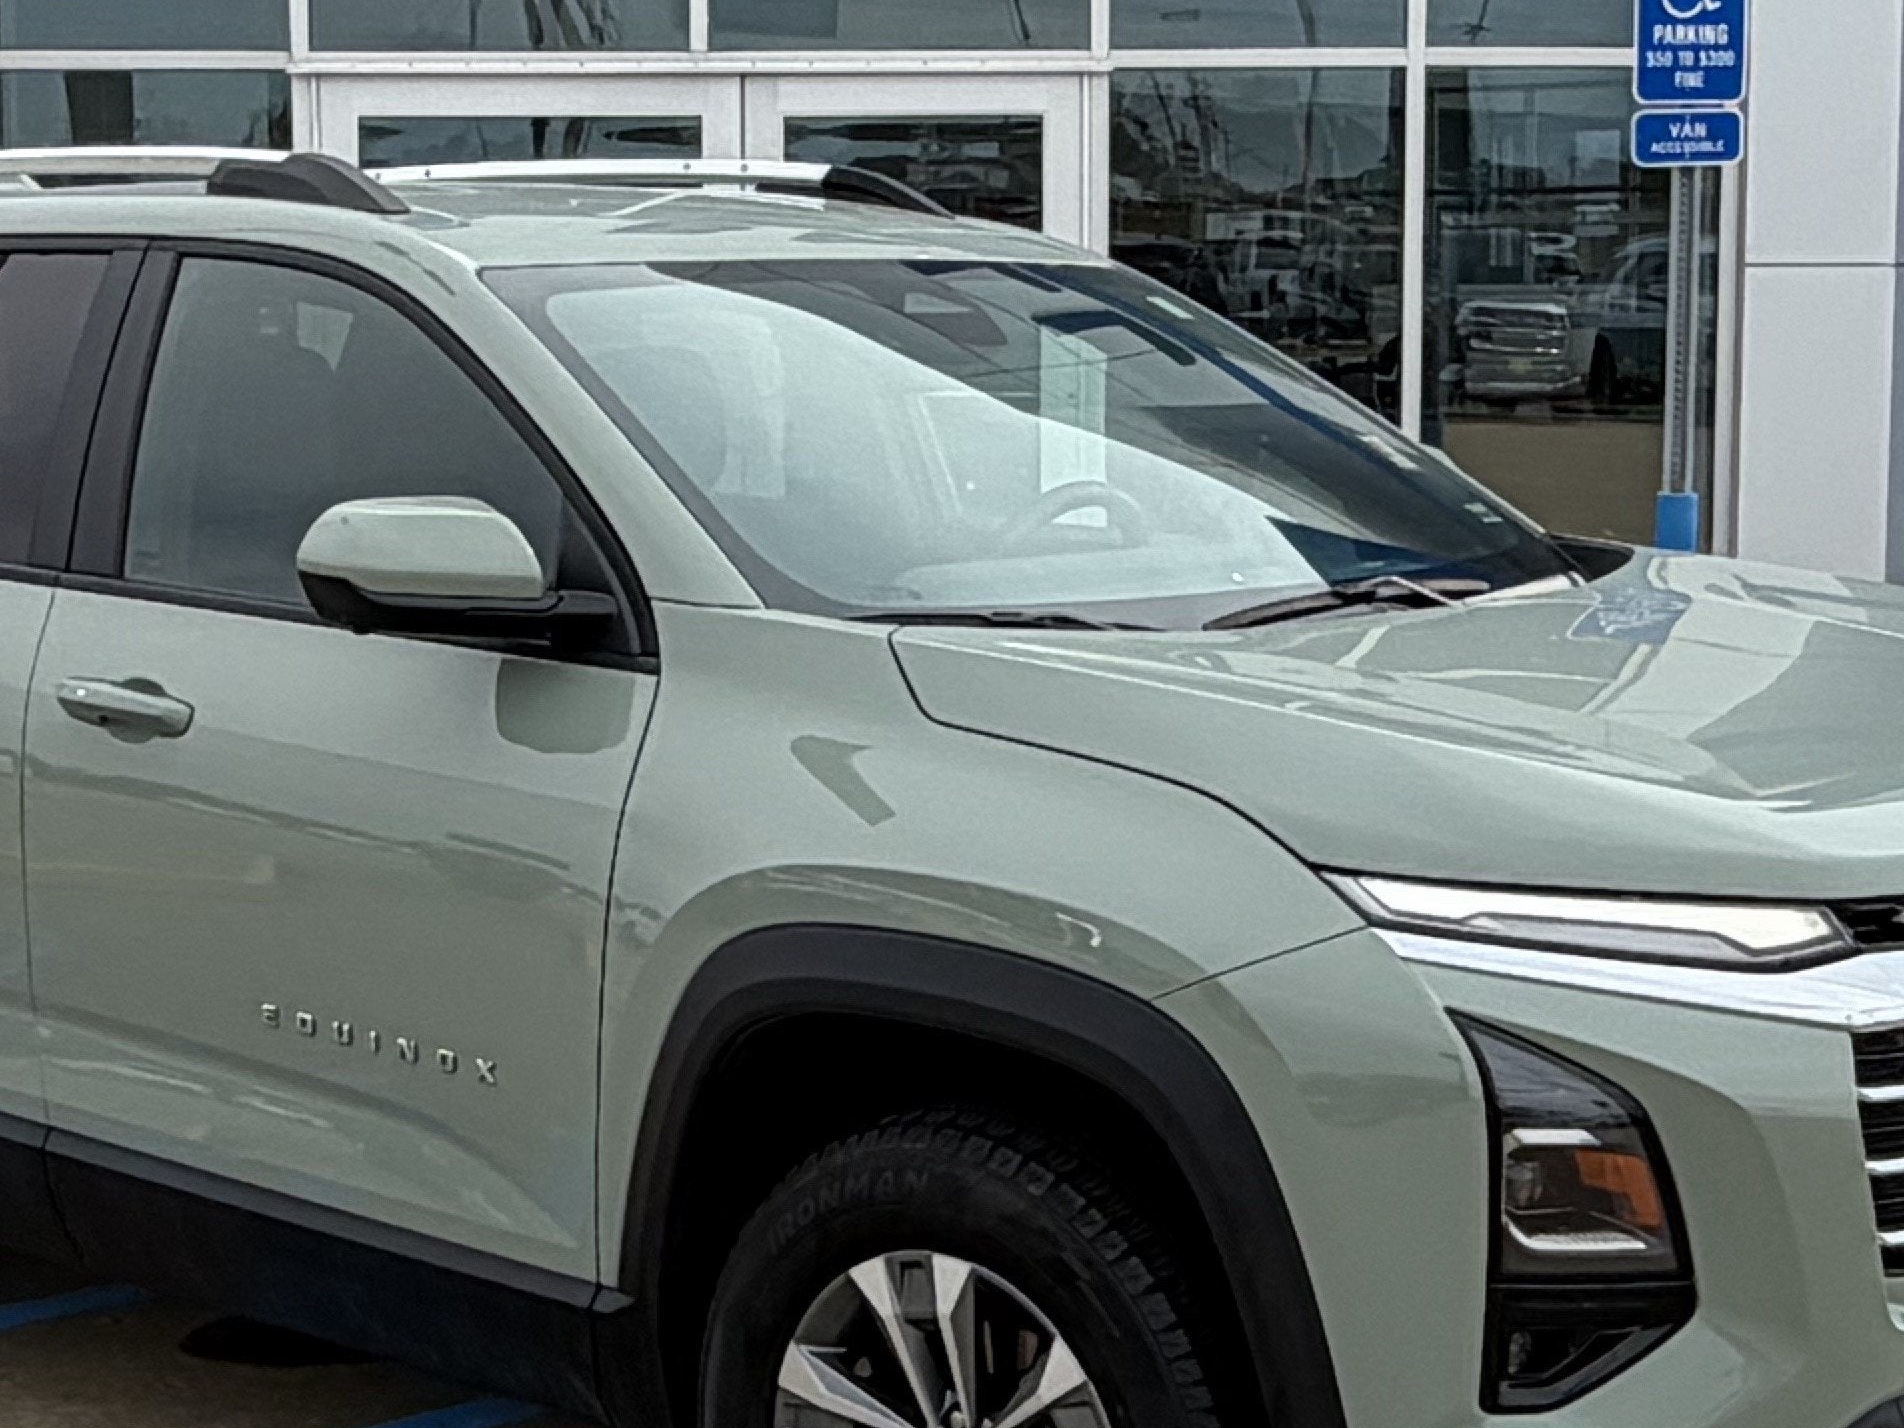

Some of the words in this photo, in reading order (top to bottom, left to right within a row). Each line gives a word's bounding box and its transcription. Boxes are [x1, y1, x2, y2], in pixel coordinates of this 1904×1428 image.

[1652, 24, 1730, 46] PARKING
[1668, 122, 1708, 138] VAN
[259, 1002, 498, 1086] EQUINOX
